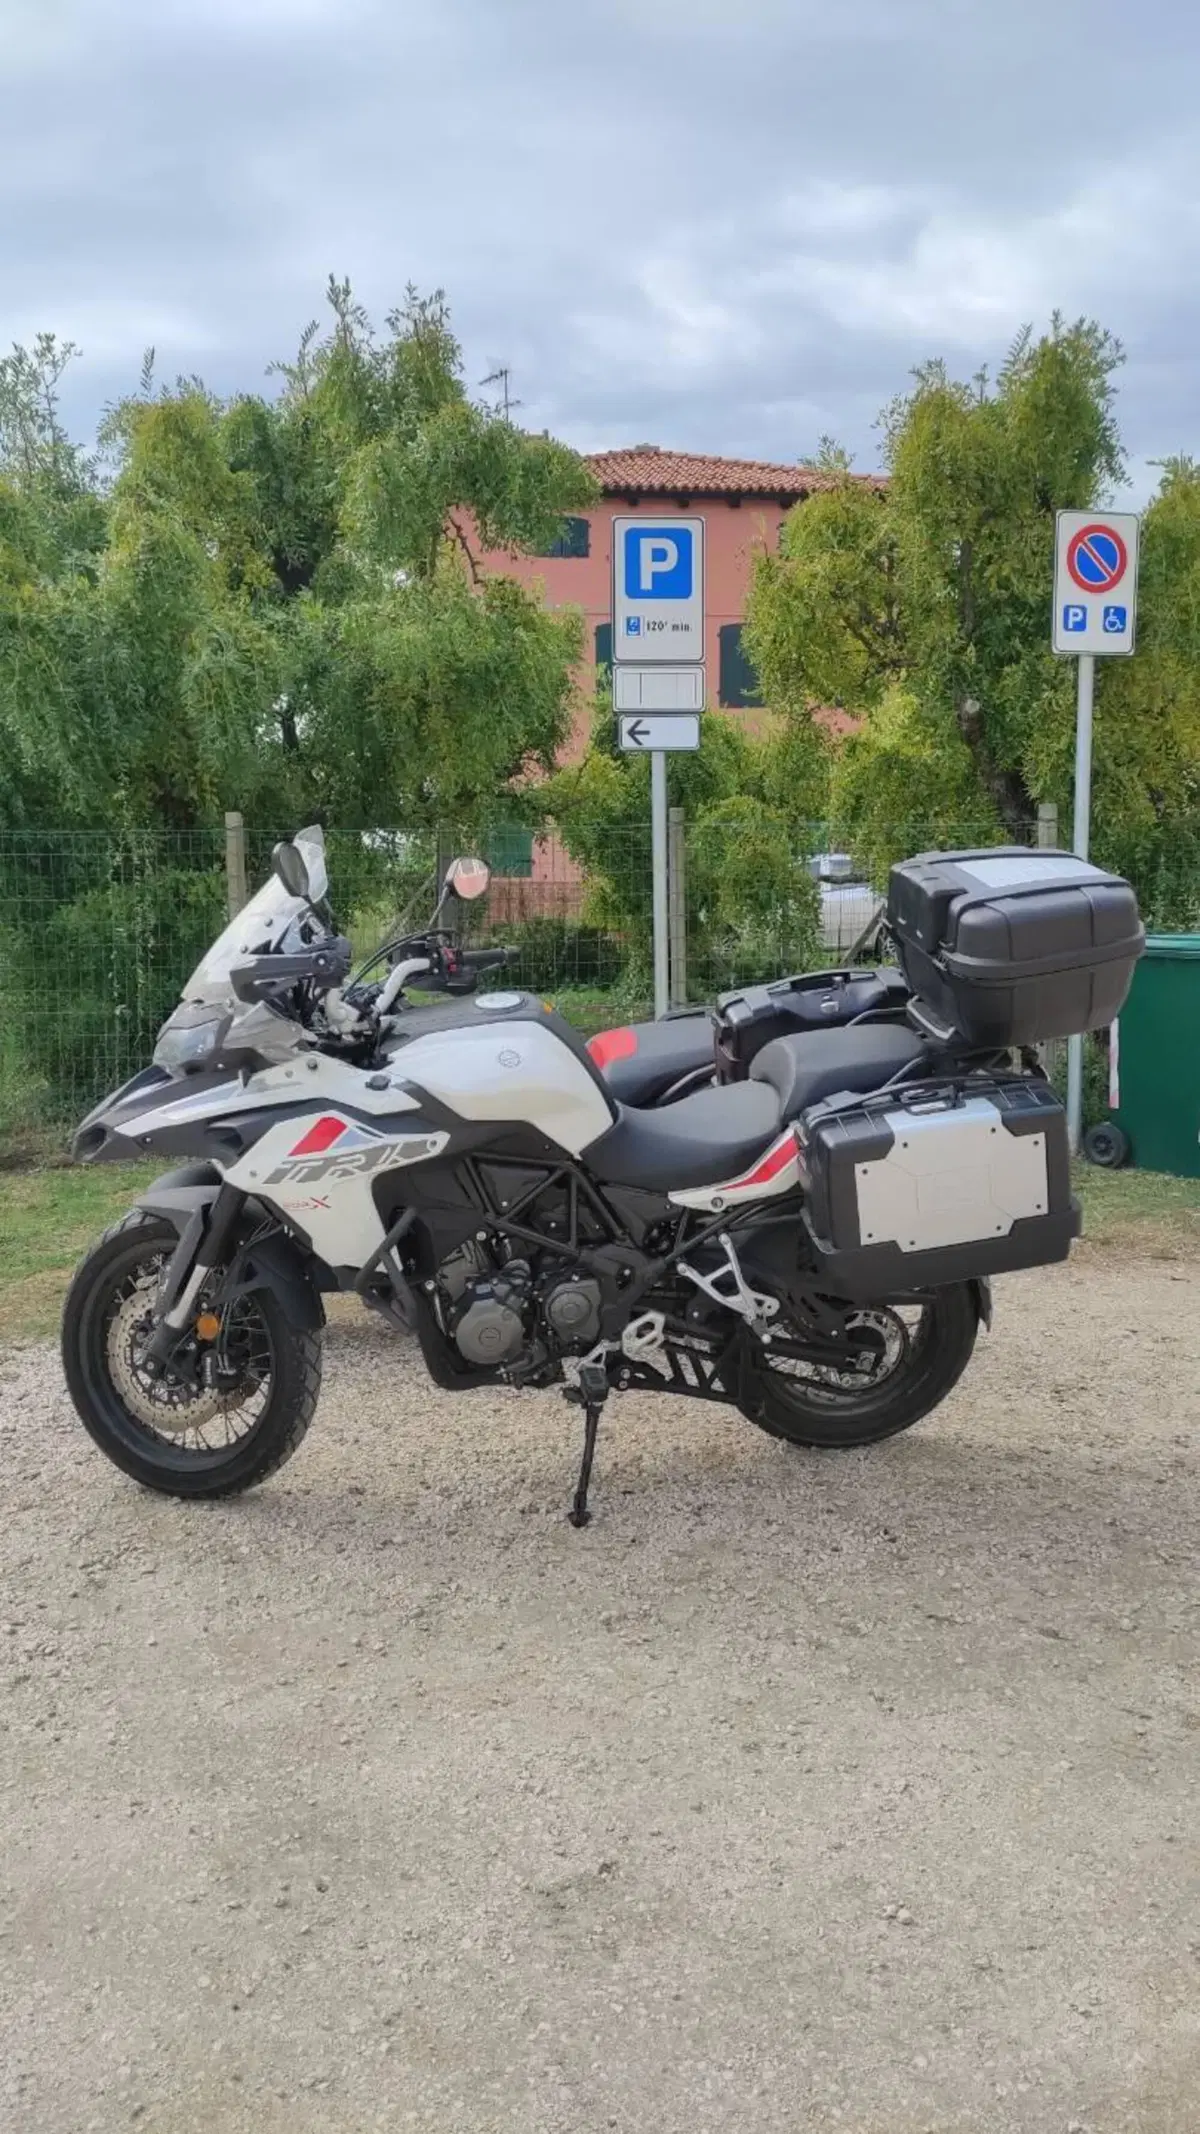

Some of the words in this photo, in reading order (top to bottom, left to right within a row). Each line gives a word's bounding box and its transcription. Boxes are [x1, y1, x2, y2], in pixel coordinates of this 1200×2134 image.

[640, 538, 679, 590] P
[1068, 608, 1083, 629] P
[266, 1140, 414, 1185] TRK
